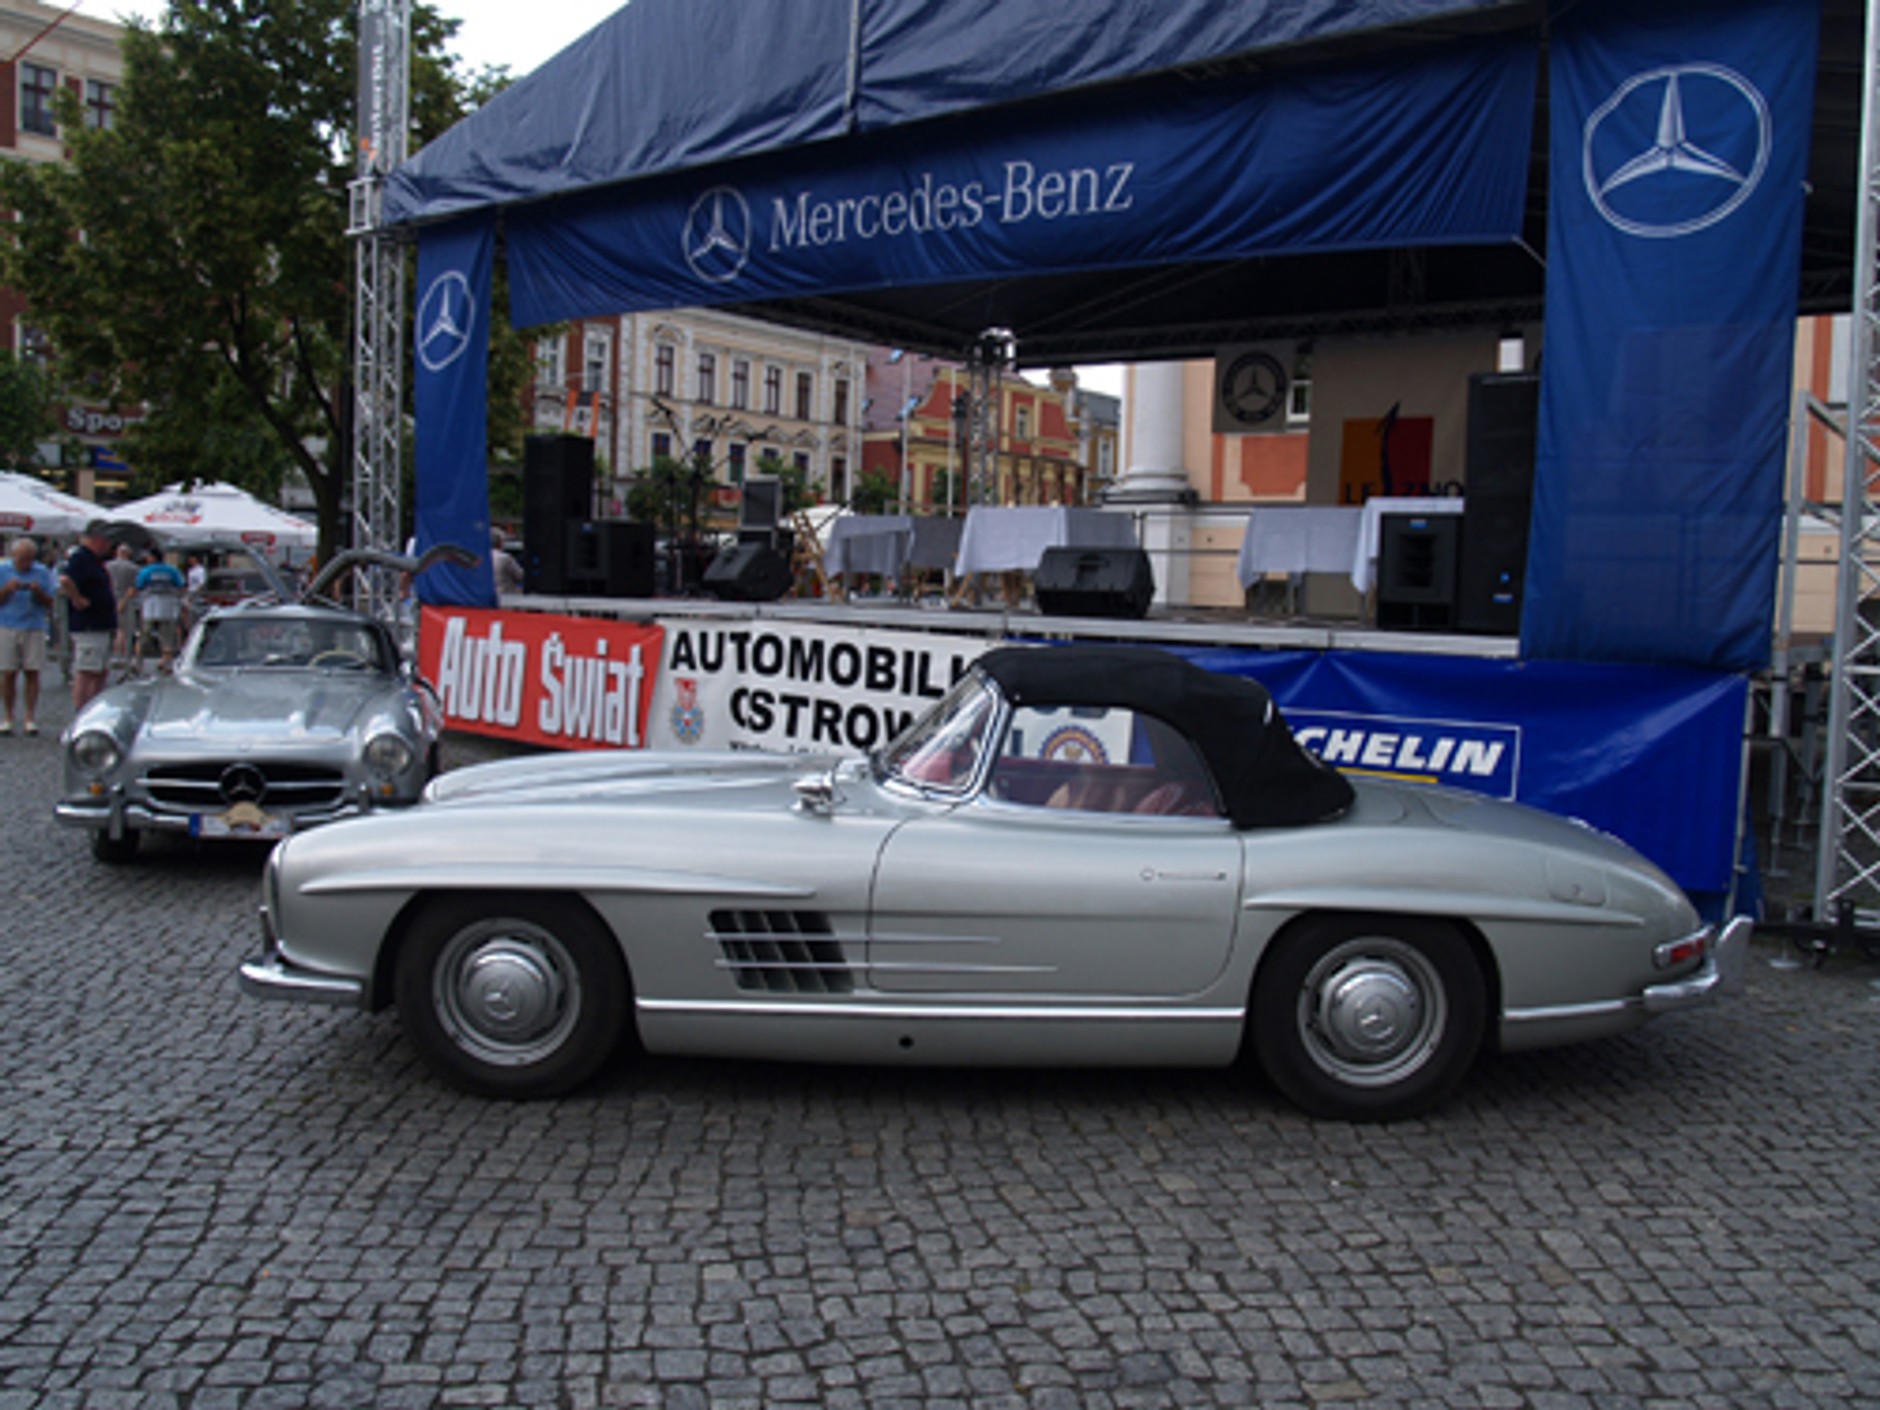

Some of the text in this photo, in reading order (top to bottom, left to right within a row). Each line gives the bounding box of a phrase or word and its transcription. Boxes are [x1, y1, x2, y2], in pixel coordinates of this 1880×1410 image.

[768, 160, 1136, 252] Mercedes-Benz
[438, 616, 644, 746] Auto Świat
[1288, 725, 1505, 776] CHELIN
